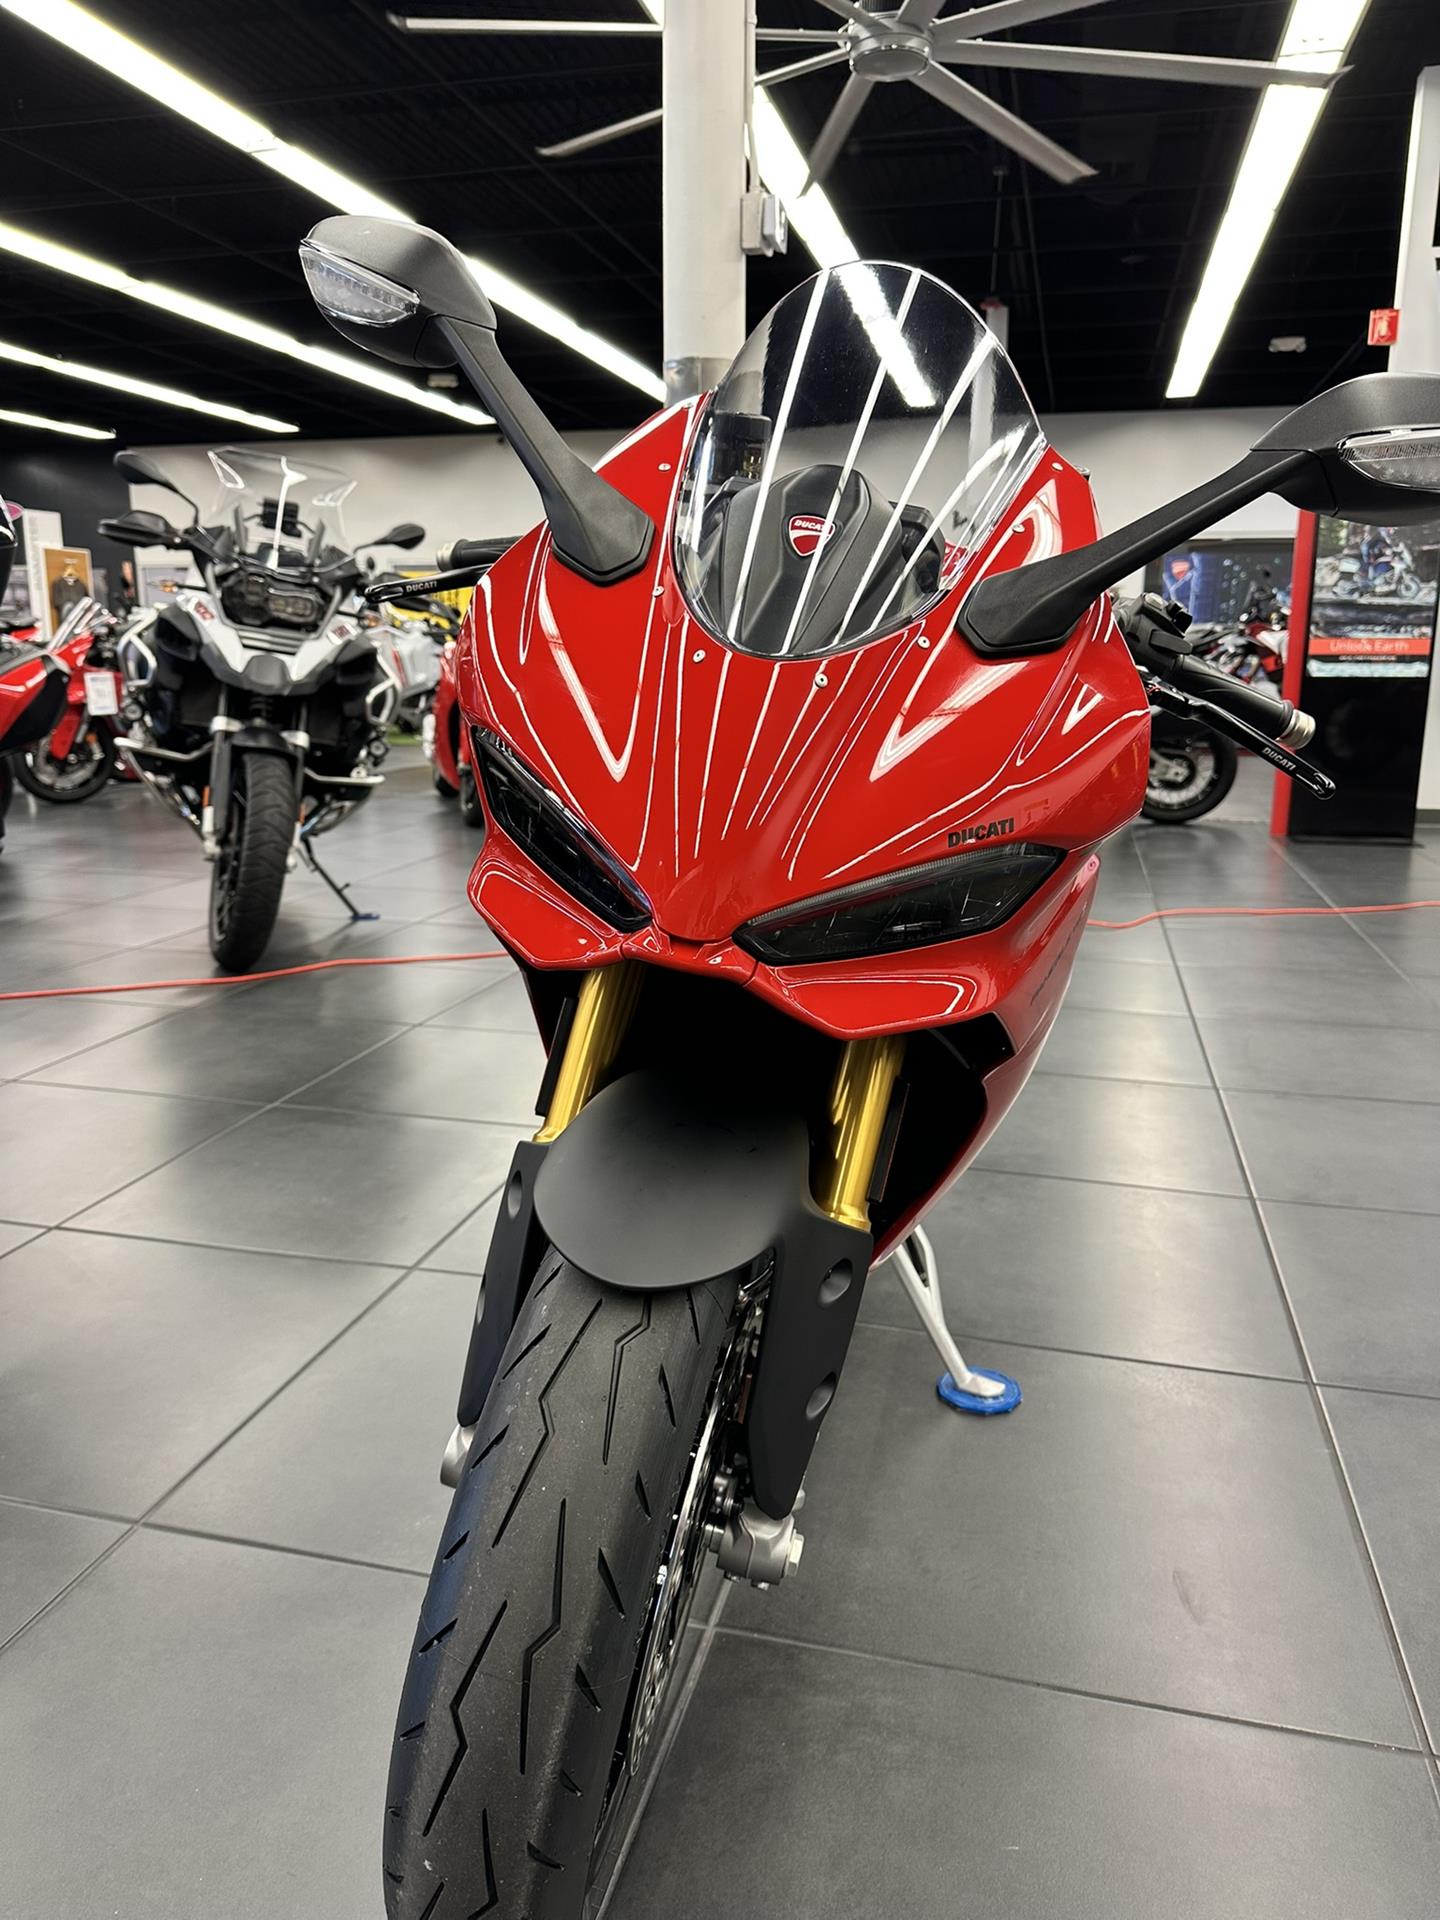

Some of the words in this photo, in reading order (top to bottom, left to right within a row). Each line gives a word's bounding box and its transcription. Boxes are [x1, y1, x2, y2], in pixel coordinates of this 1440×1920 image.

[794, 519, 828, 531] DUCA
[405, 580, 438, 593] DUCATI
[1374, 640, 1409, 652] Earth
[1262, 746, 1297, 771] DUCATI
[947, 817, 1015, 848] DUCATI
